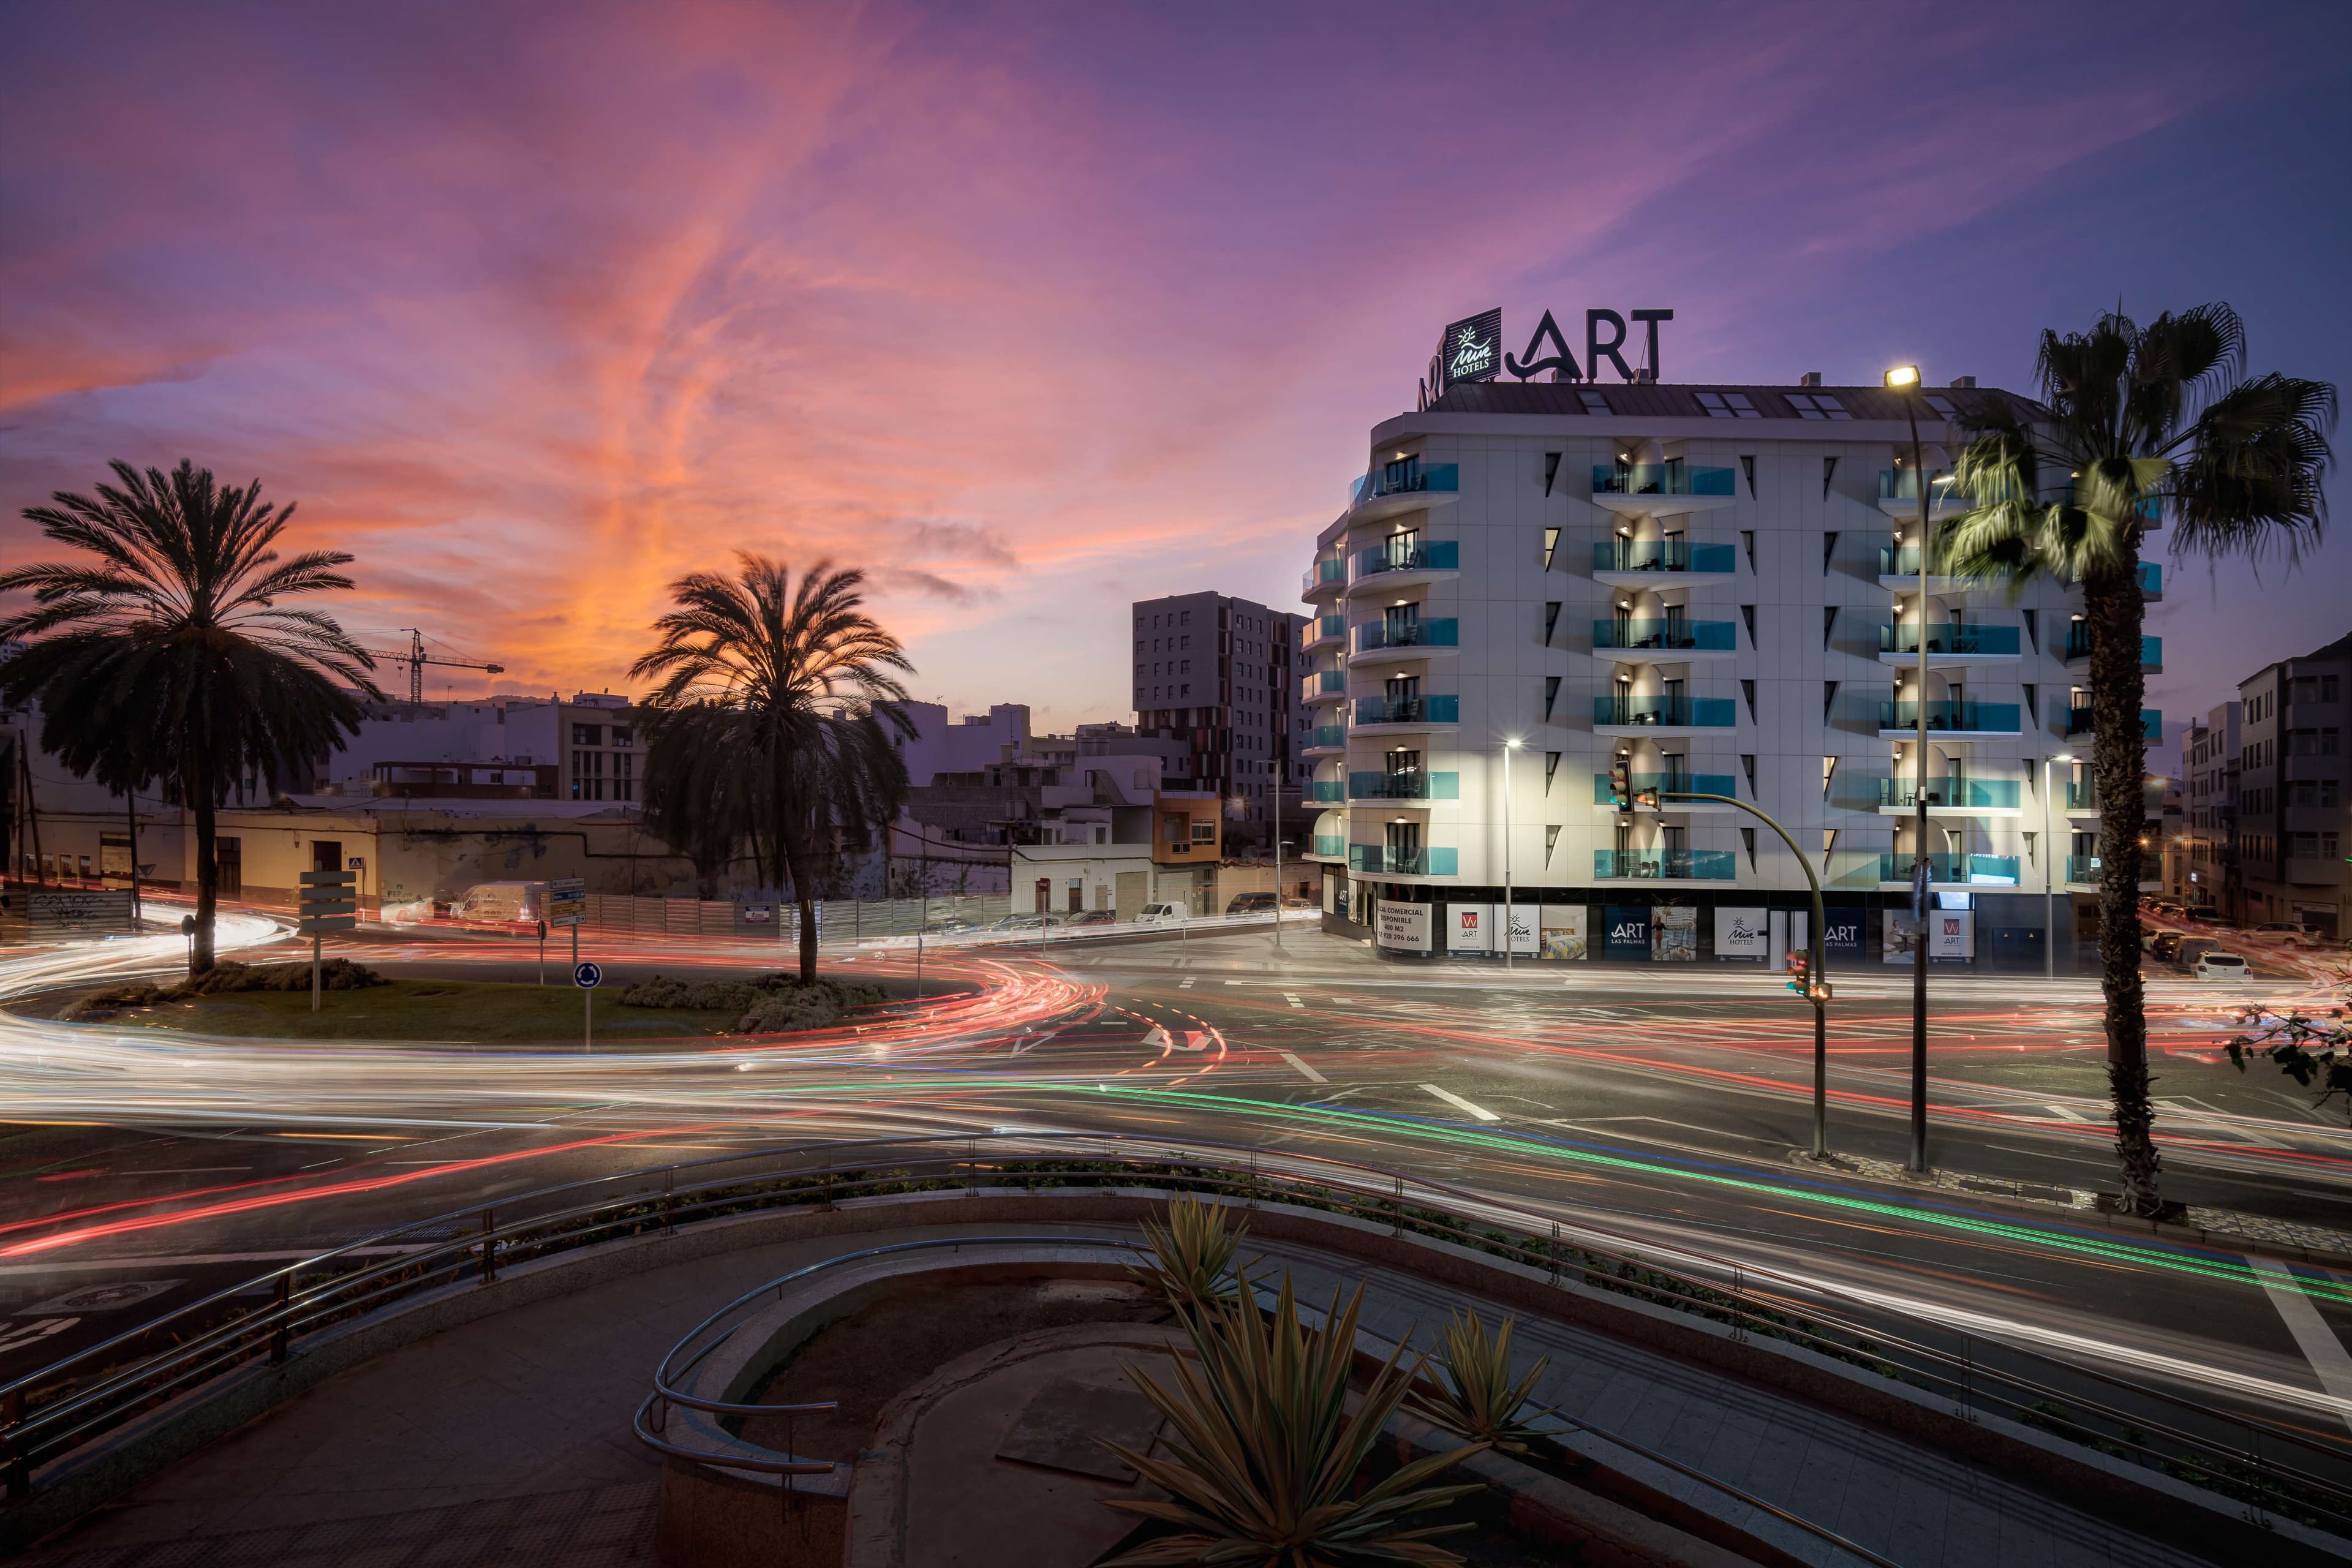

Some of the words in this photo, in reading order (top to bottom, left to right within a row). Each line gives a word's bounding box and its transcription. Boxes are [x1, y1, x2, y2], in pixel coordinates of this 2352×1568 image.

[1504, 308, 1673, 380] ART
[1453, 358, 1490, 378] HOTELS
[1339, 890, 1348, 902] ART
[1381, 915, 1412, 924] DISPONIBLE
[1387, 908, 1423, 916] COMERCIAL
[1611, 923, 1645, 938] ART
[1824, 926, 1857, 941] ART
